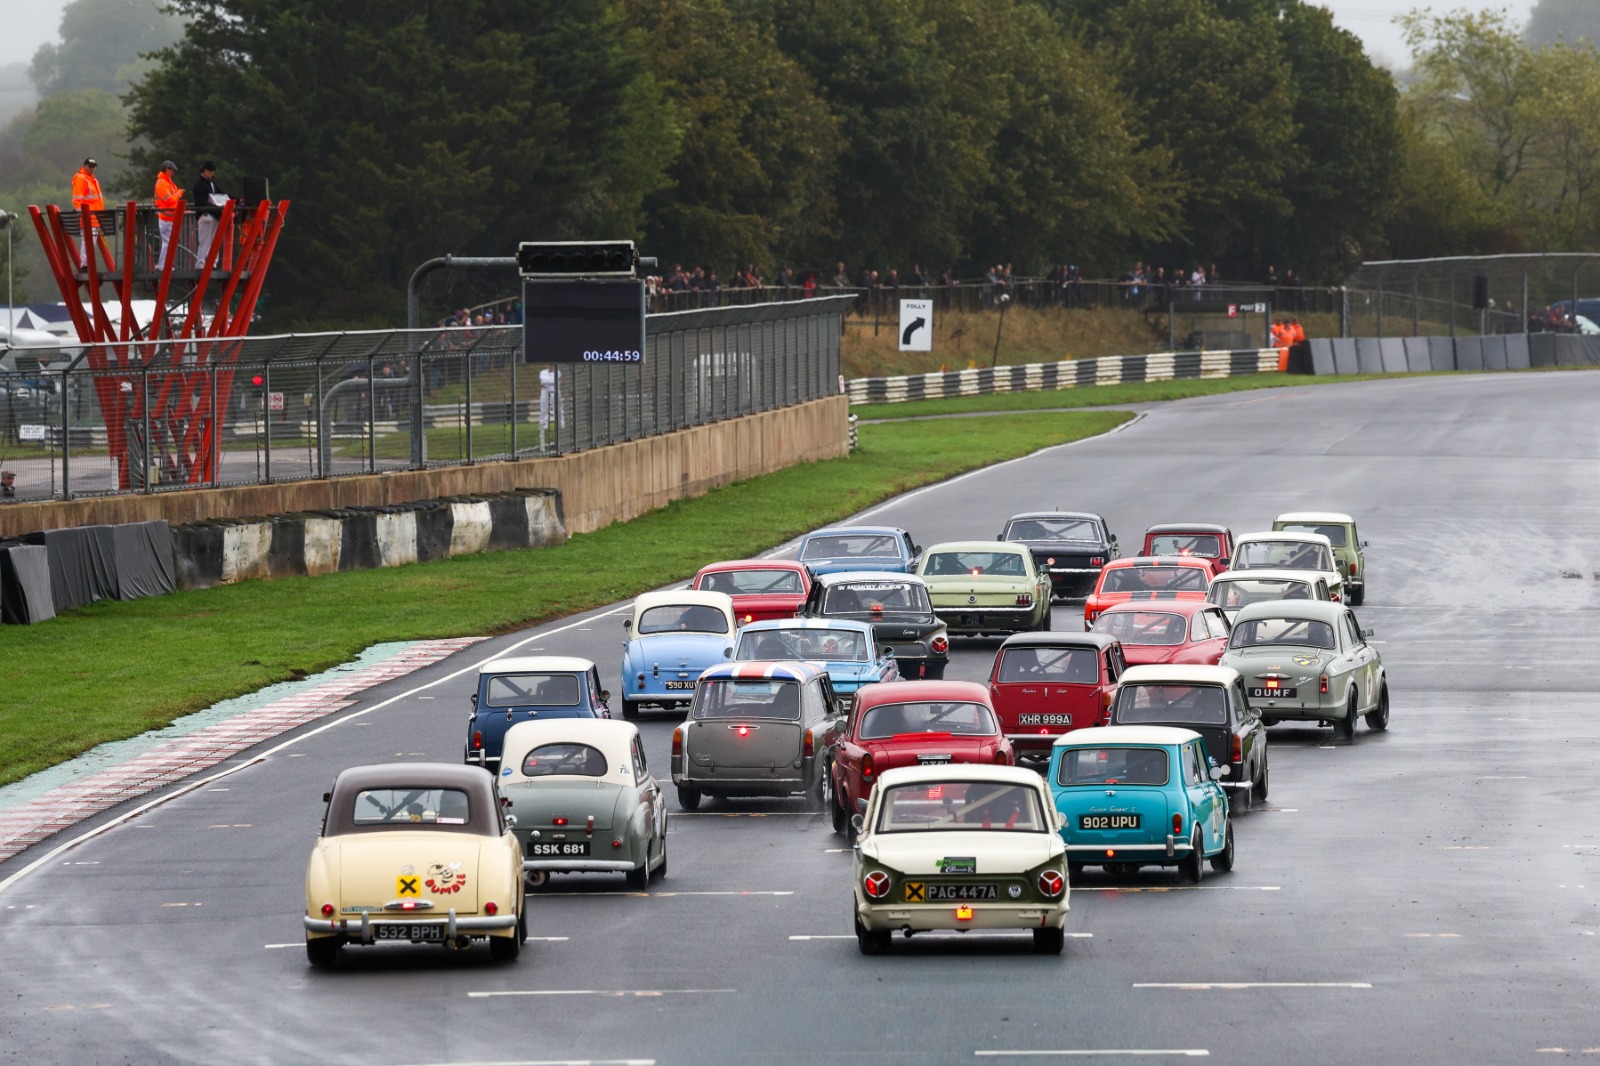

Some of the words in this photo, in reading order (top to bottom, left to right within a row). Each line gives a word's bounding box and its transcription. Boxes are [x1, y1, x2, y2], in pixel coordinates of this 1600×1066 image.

[583, 350, 640, 361] 00:44:59
[1021, 715, 1041, 724] XHR
[1042, 715, 1070, 724] 999A
[1083, 816, 1109, 828] 902
[1111, 816, 1137, 828] UPU
[534, 844, 560, 855] SSK
[563, 844, 585, 854] 681
[425, 874, 466, 895] BUMBLE
[928, 886, 957, 899] PAG
[959, 886, 997, 898] 447A
[379, 926, 407, 939] 532
[411, 926, 440, 938] BPH
